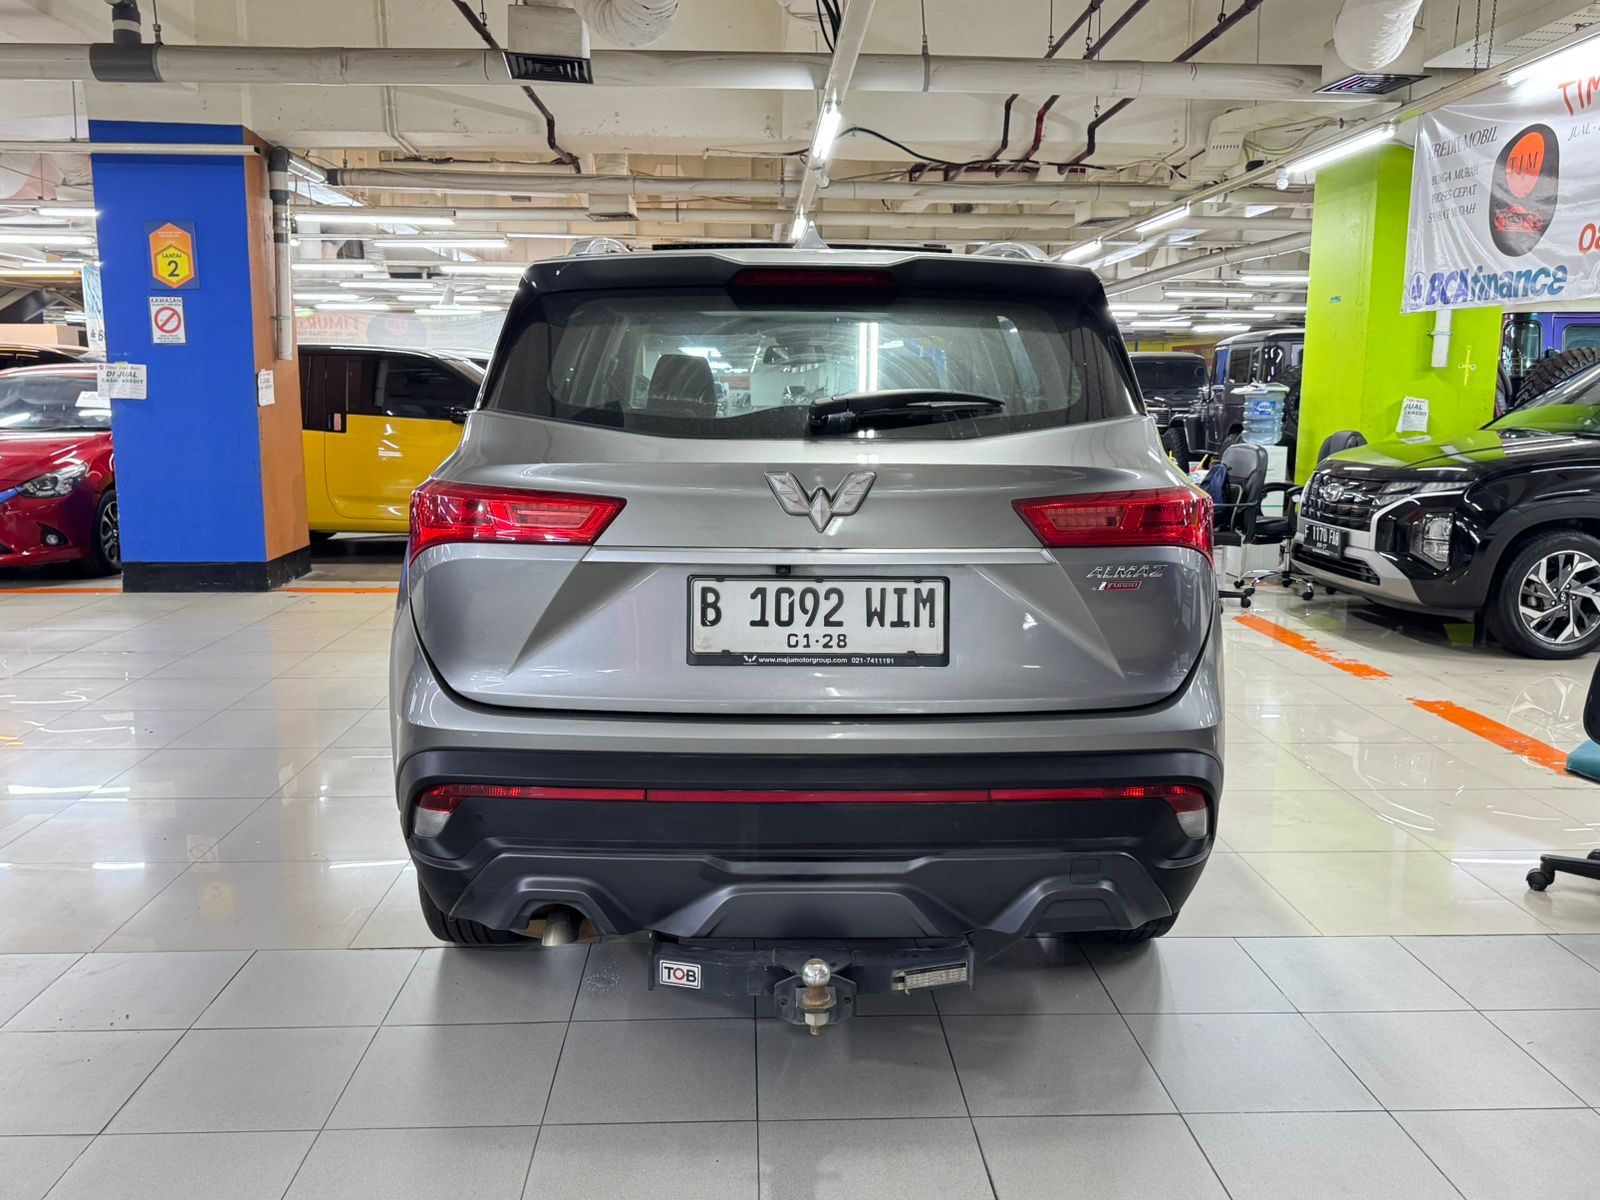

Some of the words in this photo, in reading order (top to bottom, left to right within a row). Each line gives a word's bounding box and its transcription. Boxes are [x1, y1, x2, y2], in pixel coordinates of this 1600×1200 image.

[1464, 126, 1498, 151] MOBIL
[1453, 184, 1477, 199] CEPAT
[167, 260, 180, 277] 2
[117, 370, 138, 378] JUAL
[1304, 524, 1309, 538] F
[1312, 526, 1328, 542] 1170
[700, 587, 722, 627] B
[749, 587, 844, 627] 1092
[865, 587, 936, 628] WIM
[758, 656, 848, 665] www.majumotorgroup.com
[851, 656, 895, 664] 021-7411191
[663, 965, 697, 983] TOB
